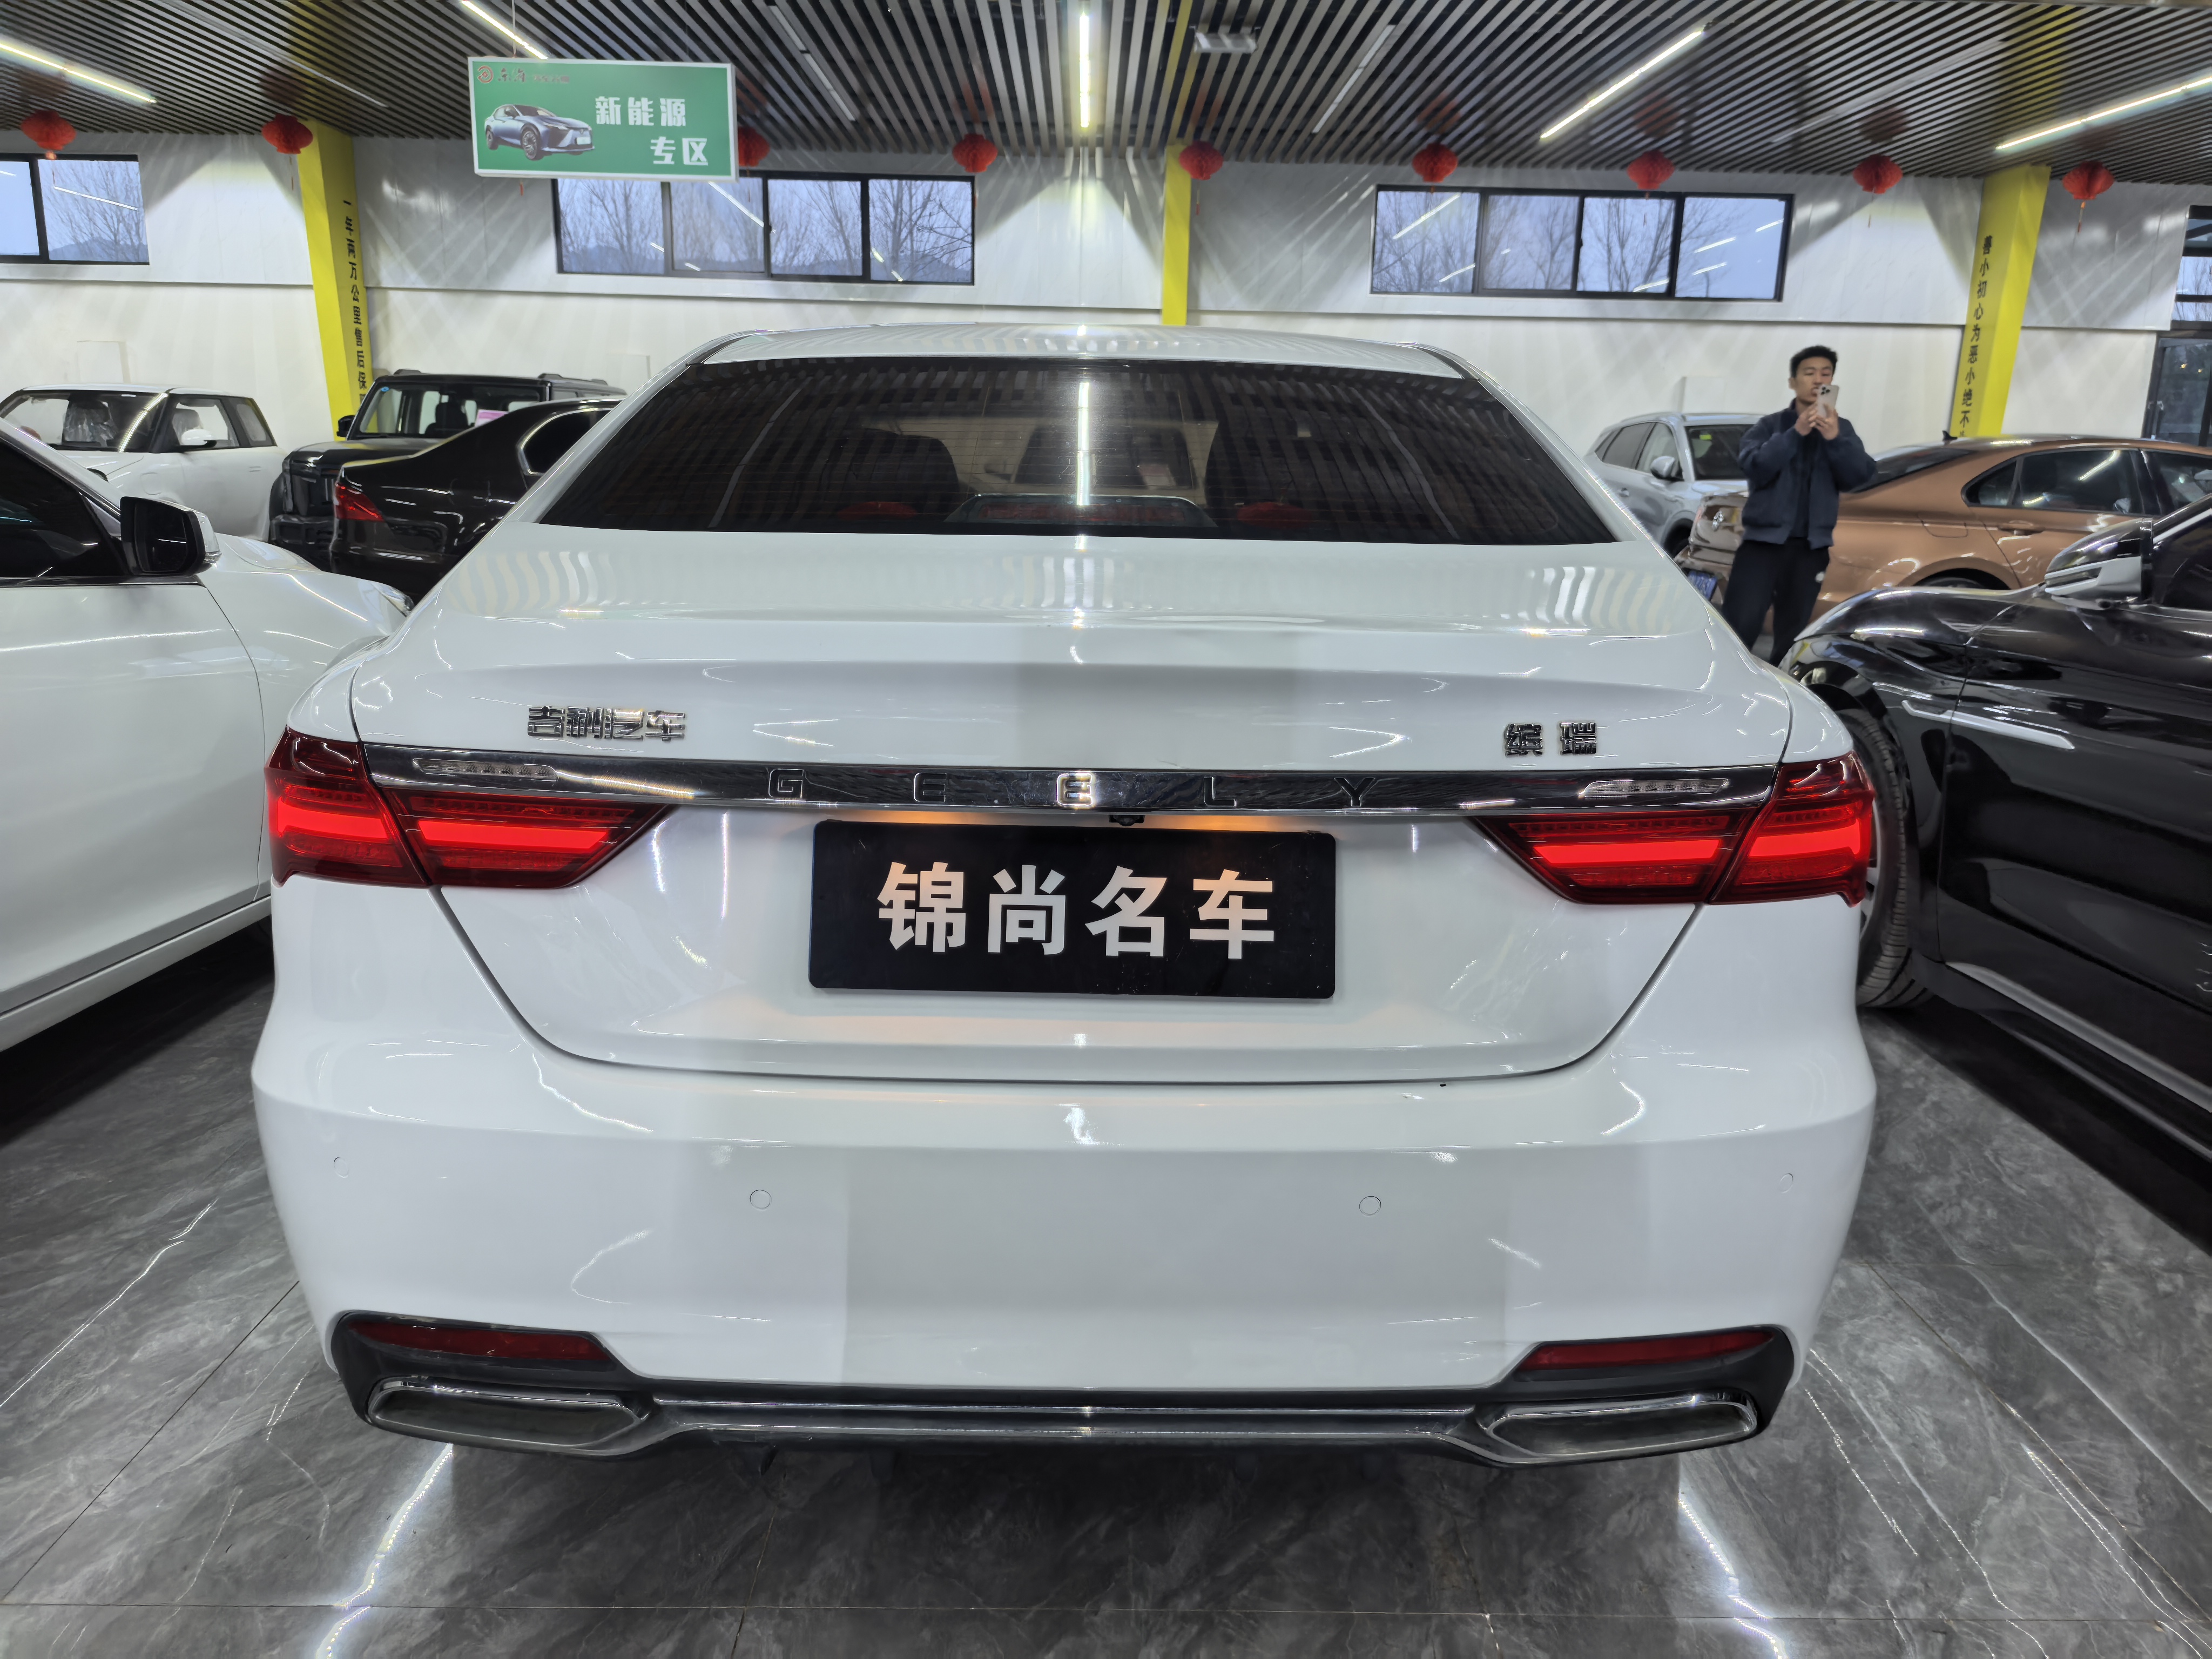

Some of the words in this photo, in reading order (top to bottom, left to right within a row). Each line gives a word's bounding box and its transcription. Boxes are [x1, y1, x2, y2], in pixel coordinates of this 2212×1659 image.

[595, 96, 686, 126] 新能源
[650, 137, 709, 166] 专区
[528, 706, 685, 741] 吉利汽车
[1505, 722, 1596, 756] 缤瑞
[768, 768, 1375, 808] GEELY
[877, 862, 1274, 960] 锦尚名车
